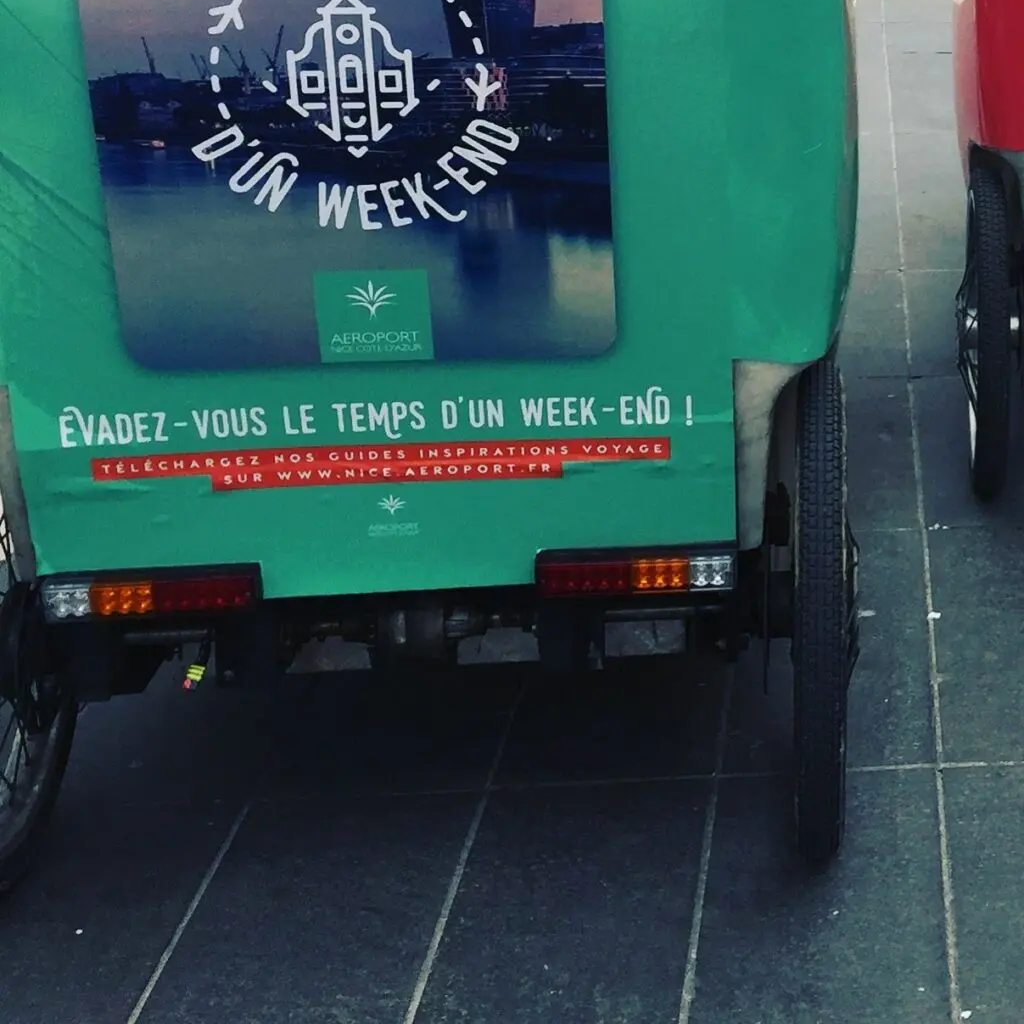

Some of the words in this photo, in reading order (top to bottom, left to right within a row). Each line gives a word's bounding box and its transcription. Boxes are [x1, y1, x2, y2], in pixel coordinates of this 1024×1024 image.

[191, 123, 299, 213] D'UN
[317, 118, 520, 230] WEEK-END
[330, 330, 420, 345] AEROPORT
[282, 404, 317, 436] LE
[331, 400, 426, 440] TEMPS
[441, 395, 504, 430] D'UN
[520, 386, 671, 427] WEEK-END
[101, 455, 260, 475] TÉLÉCHARGEZ
[274, 451, 315, 465] NOS
[328, 448, 406, 462] GUIDES
[419, 444, 569, 459] INSPIRATIONS
[582, 443, 664, 455] VOYAGE
[223, 472, 263, 485] SUR
